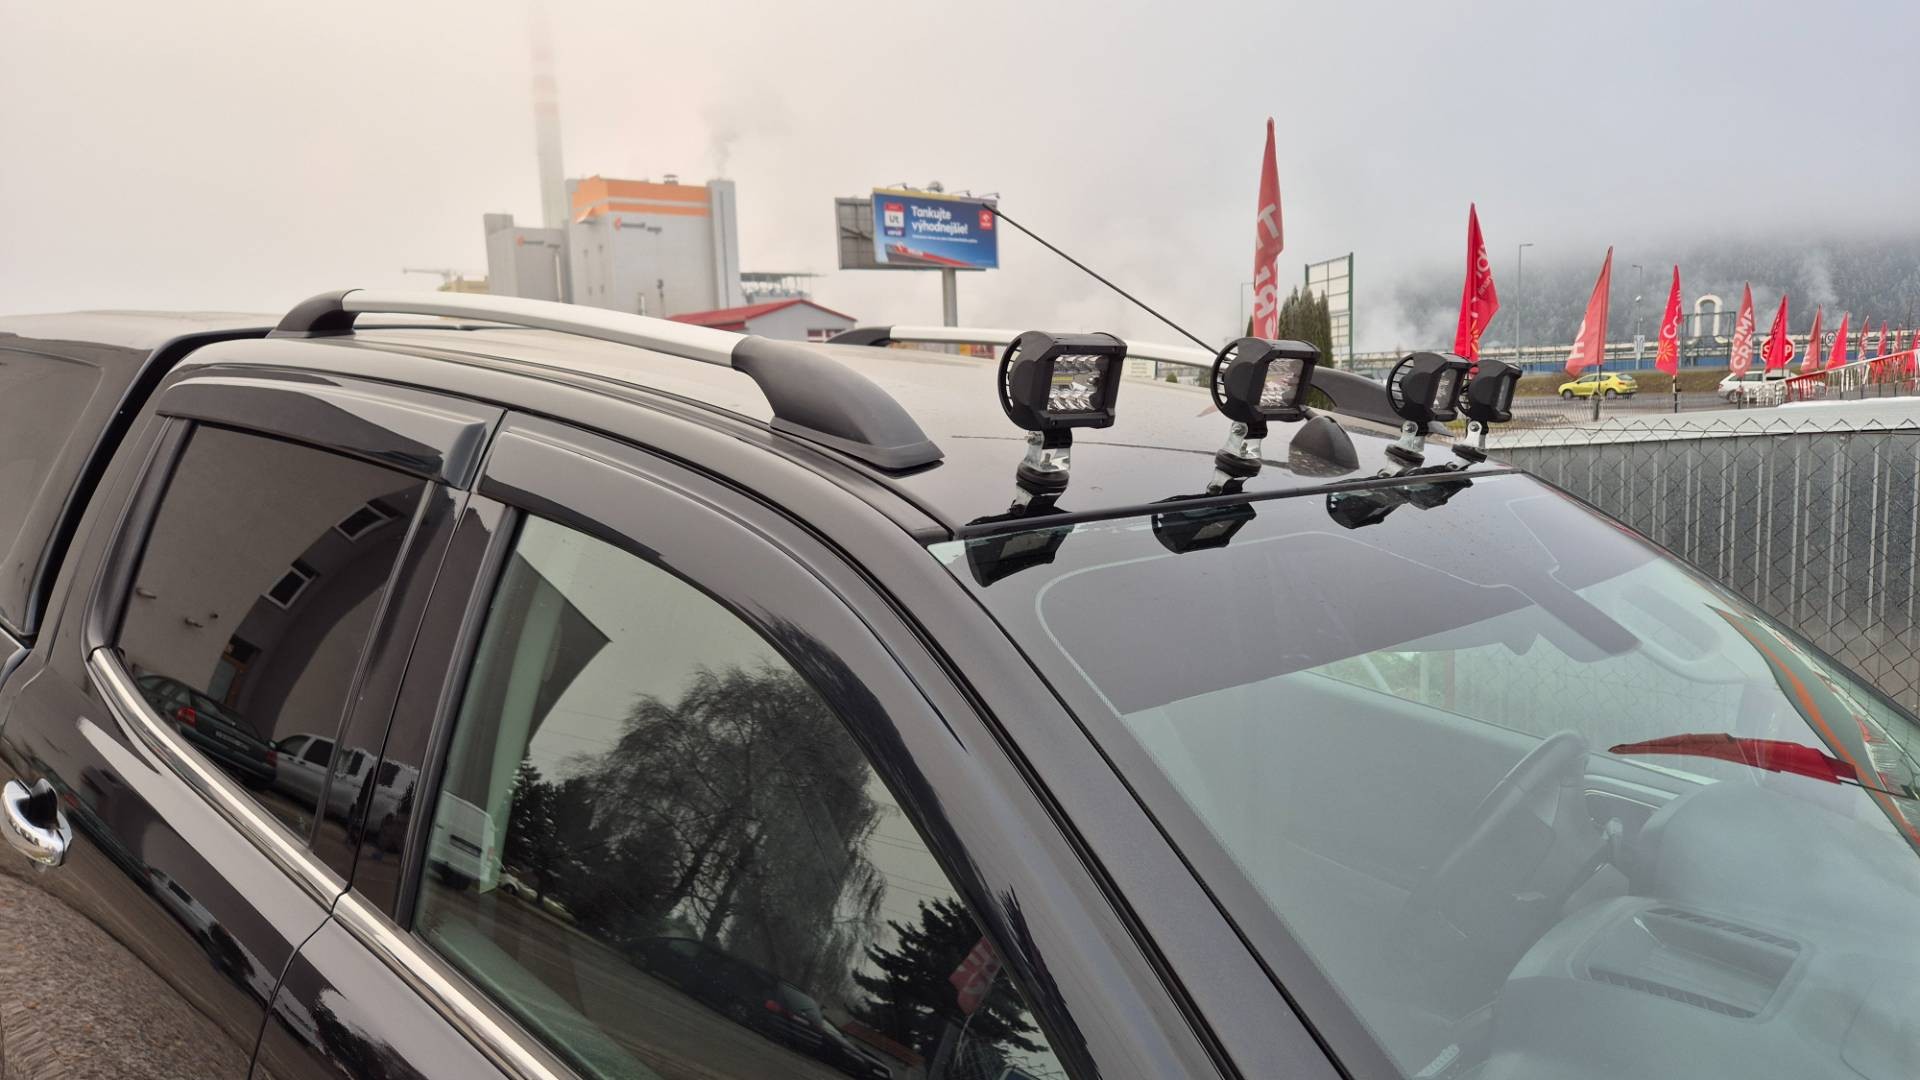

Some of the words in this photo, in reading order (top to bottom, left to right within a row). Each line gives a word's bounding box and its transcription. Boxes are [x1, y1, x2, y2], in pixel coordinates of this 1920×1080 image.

[911, 205, 953, 221] Tankujte
[911, 220, 969, 235] výhodnejšie!
[1763, 344, 1792, 357] SP
